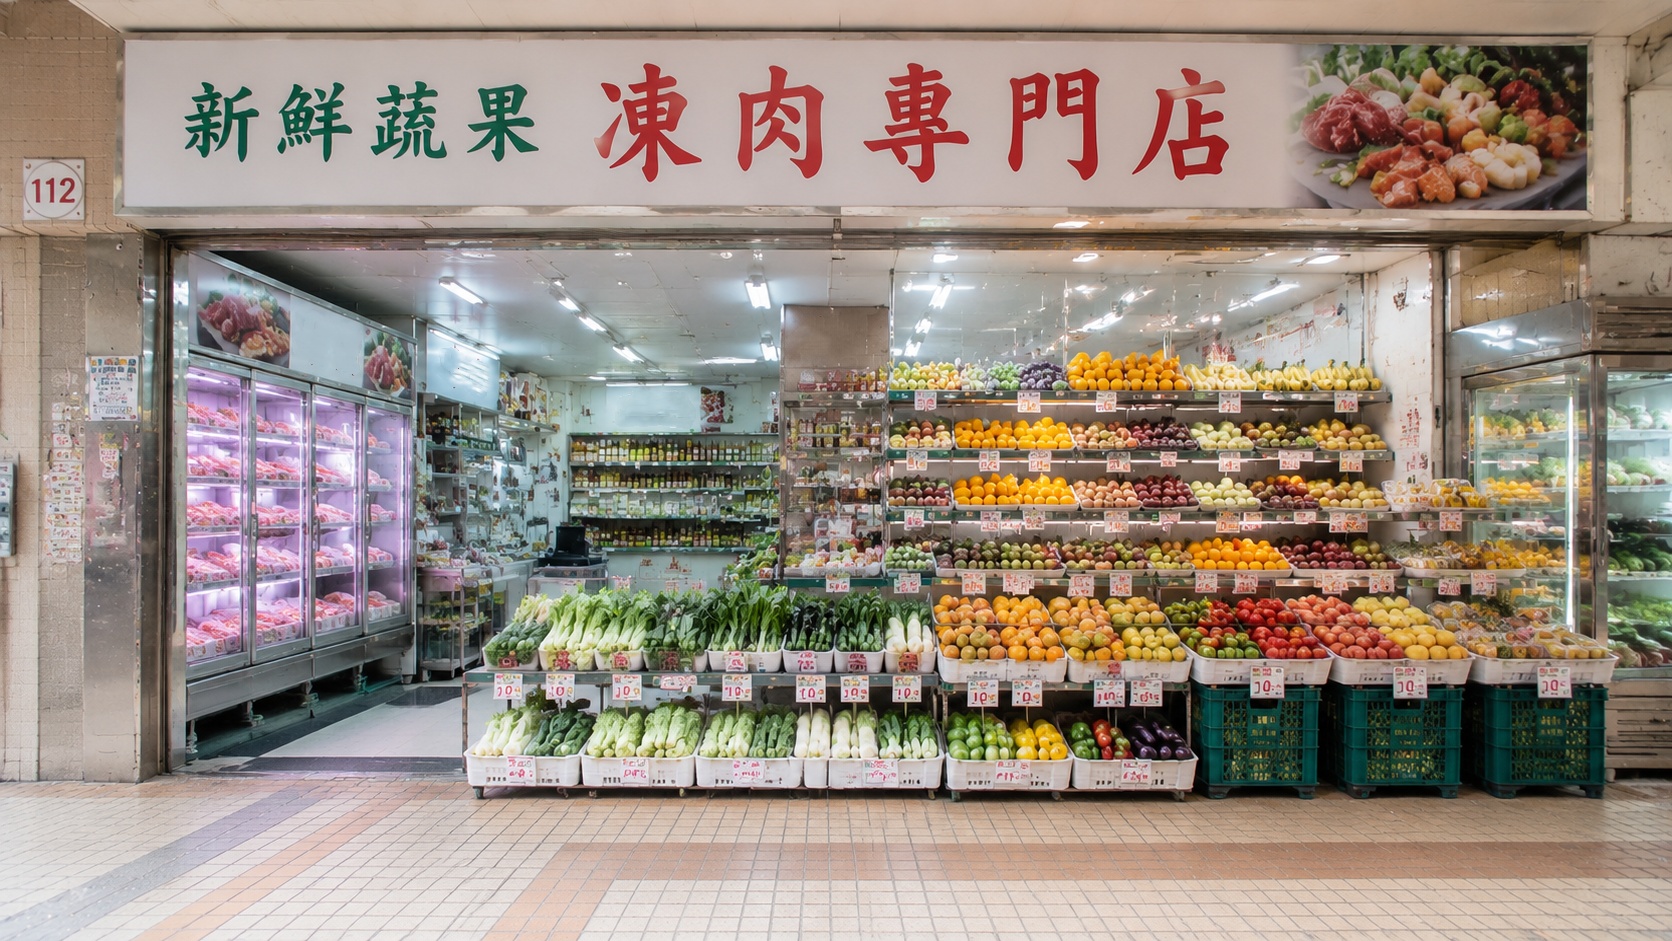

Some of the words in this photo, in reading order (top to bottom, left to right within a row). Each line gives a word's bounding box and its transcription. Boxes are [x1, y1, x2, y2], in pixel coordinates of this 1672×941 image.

[186, 82, 537, 161] 新鮮蔬果
[594, 63, 1229, 183] 凍肉專門店
[32, 177, 76, 204] 112
